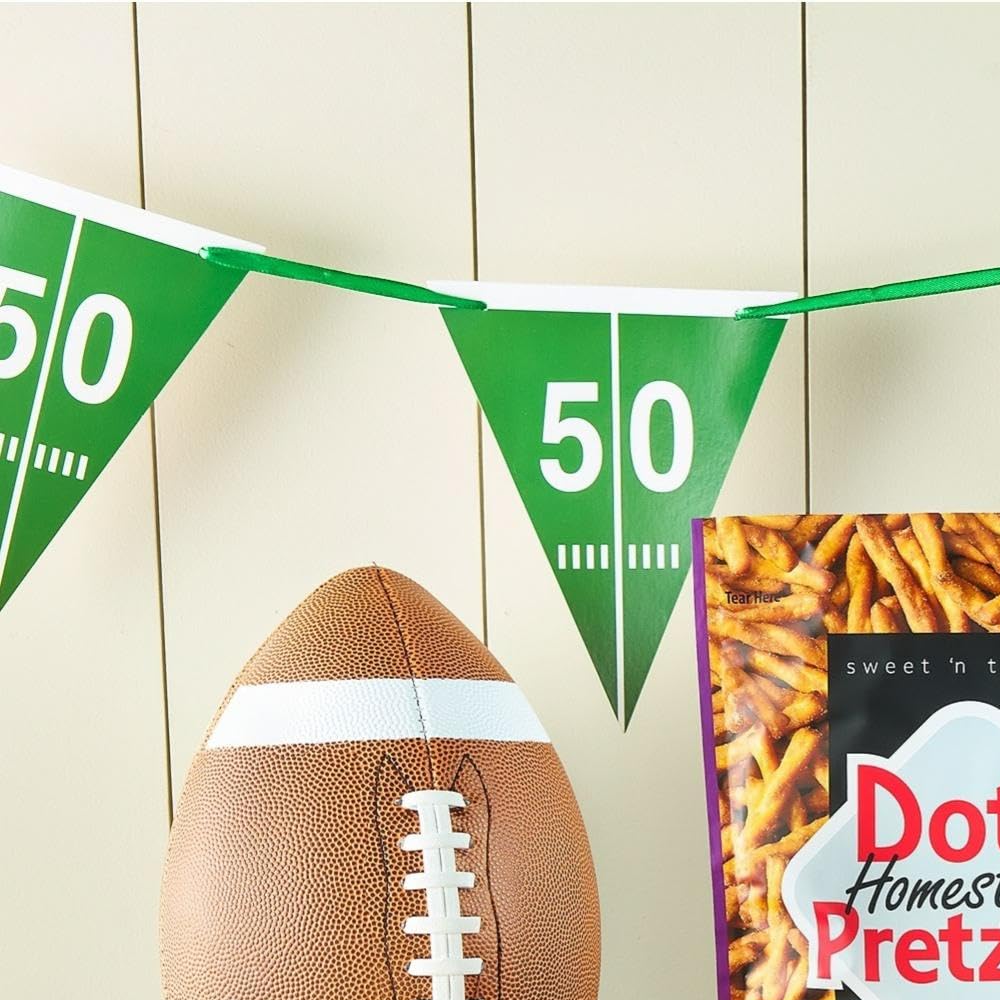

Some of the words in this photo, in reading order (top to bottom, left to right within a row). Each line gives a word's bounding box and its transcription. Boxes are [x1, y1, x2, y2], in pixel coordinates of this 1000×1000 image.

[539, 380, 694, 493] 50
[725, 591, 750, 605] Tear
[754, 590, 781, 603] Here
[846, 658, 930, 675] sweet
